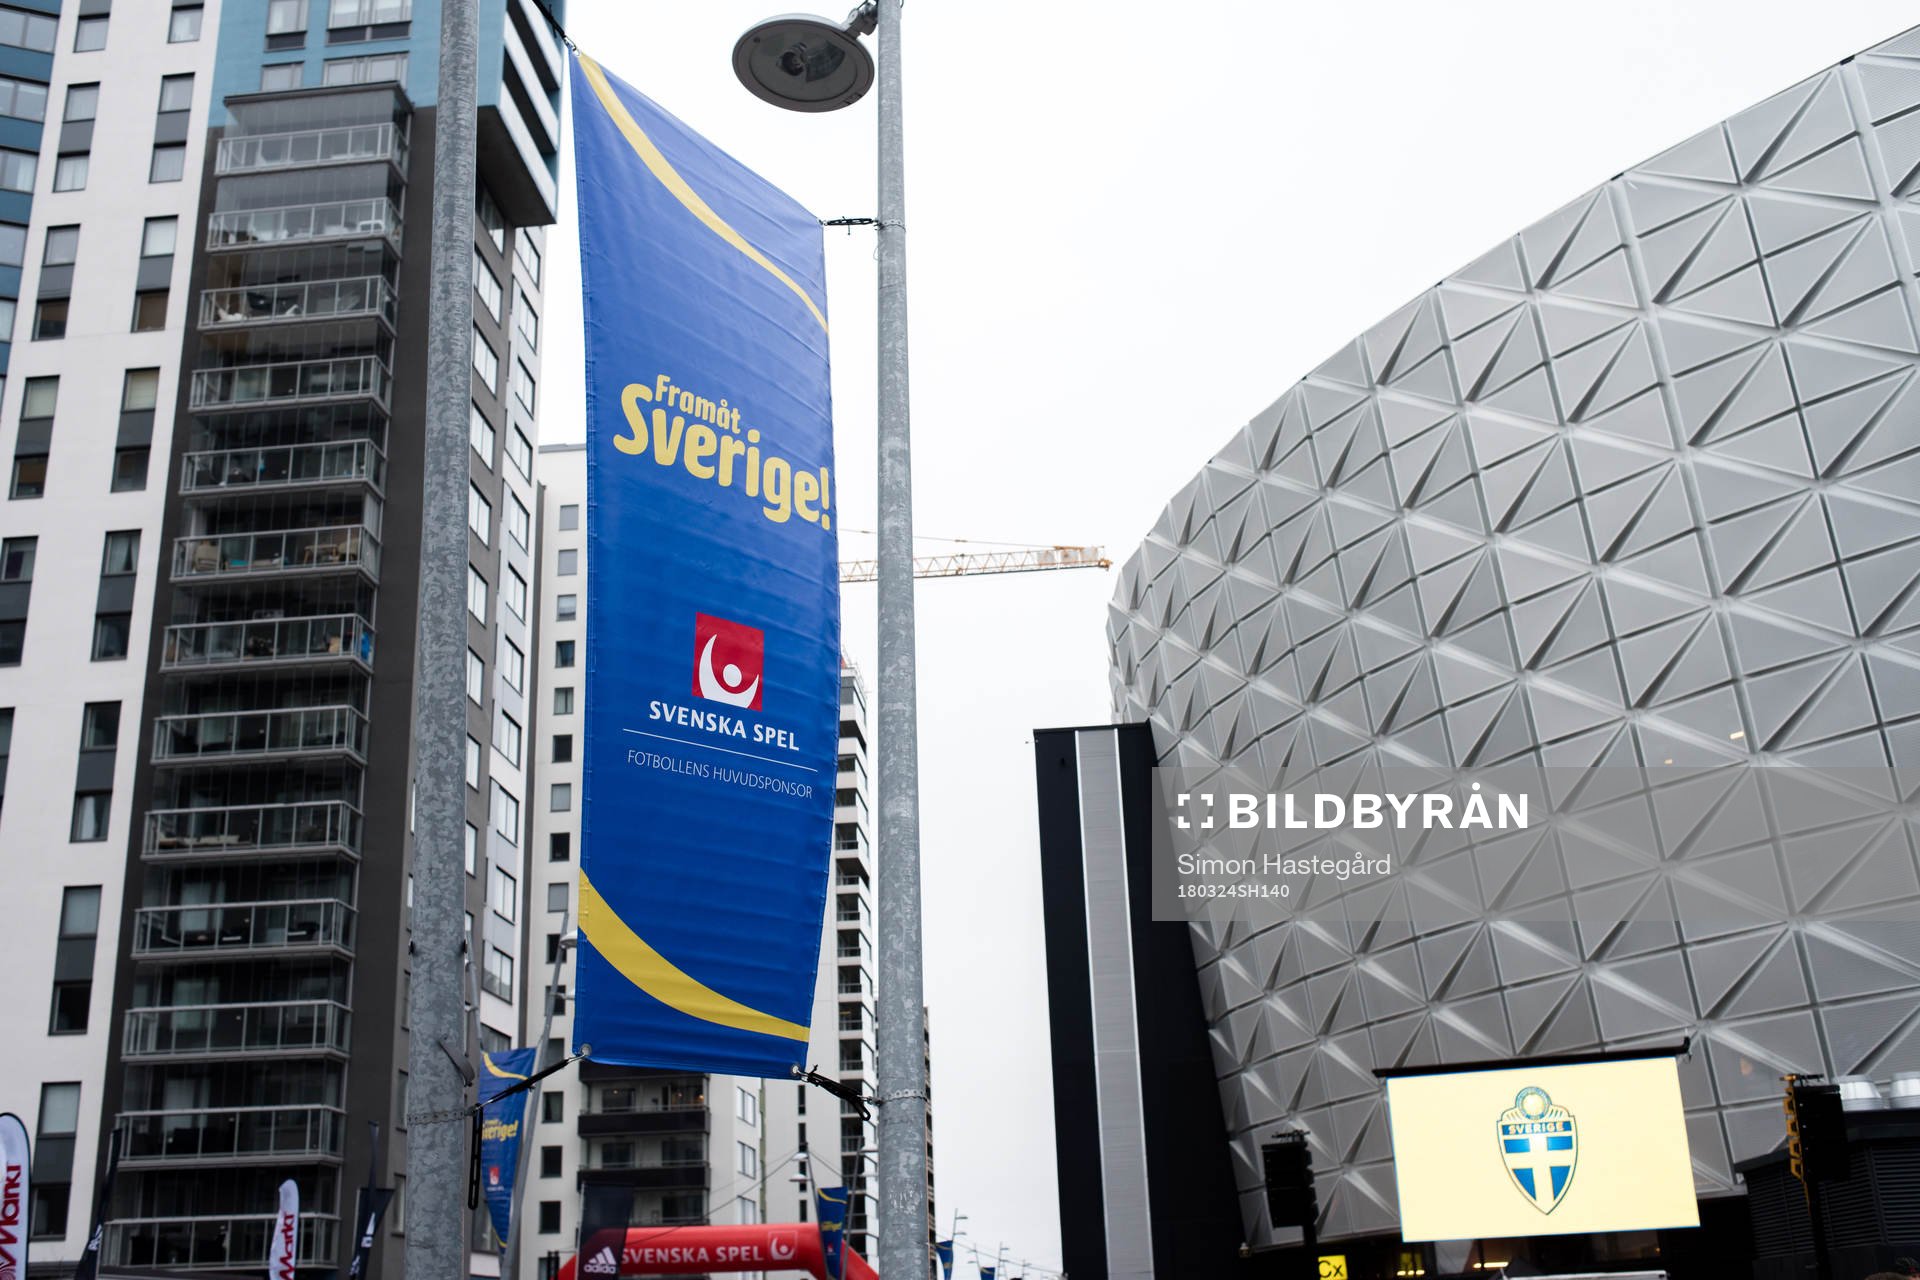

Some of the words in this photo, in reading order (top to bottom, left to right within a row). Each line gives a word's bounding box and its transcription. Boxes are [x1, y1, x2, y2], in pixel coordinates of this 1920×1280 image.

[655, 374, 741, 434] Framåt
[613, 383, 830, 530] Sverige!
[649, 700, 747, 739] SVENSKA
[753, 724, 800, 751] SPEL
[627, 749, 710, 778] FOTBOLLENS
[713, 766, 813, 799] HUVUDSPONSOR
[481, 1120, 519, 1141] verige!
[1508, 1121, 1564, 1135] SVERIGE
[584, 1263, 617, 1275] adida
[621, 1247, 710, 1265] SVENSKA
[716, 1245, 764, 1262] SPEL
